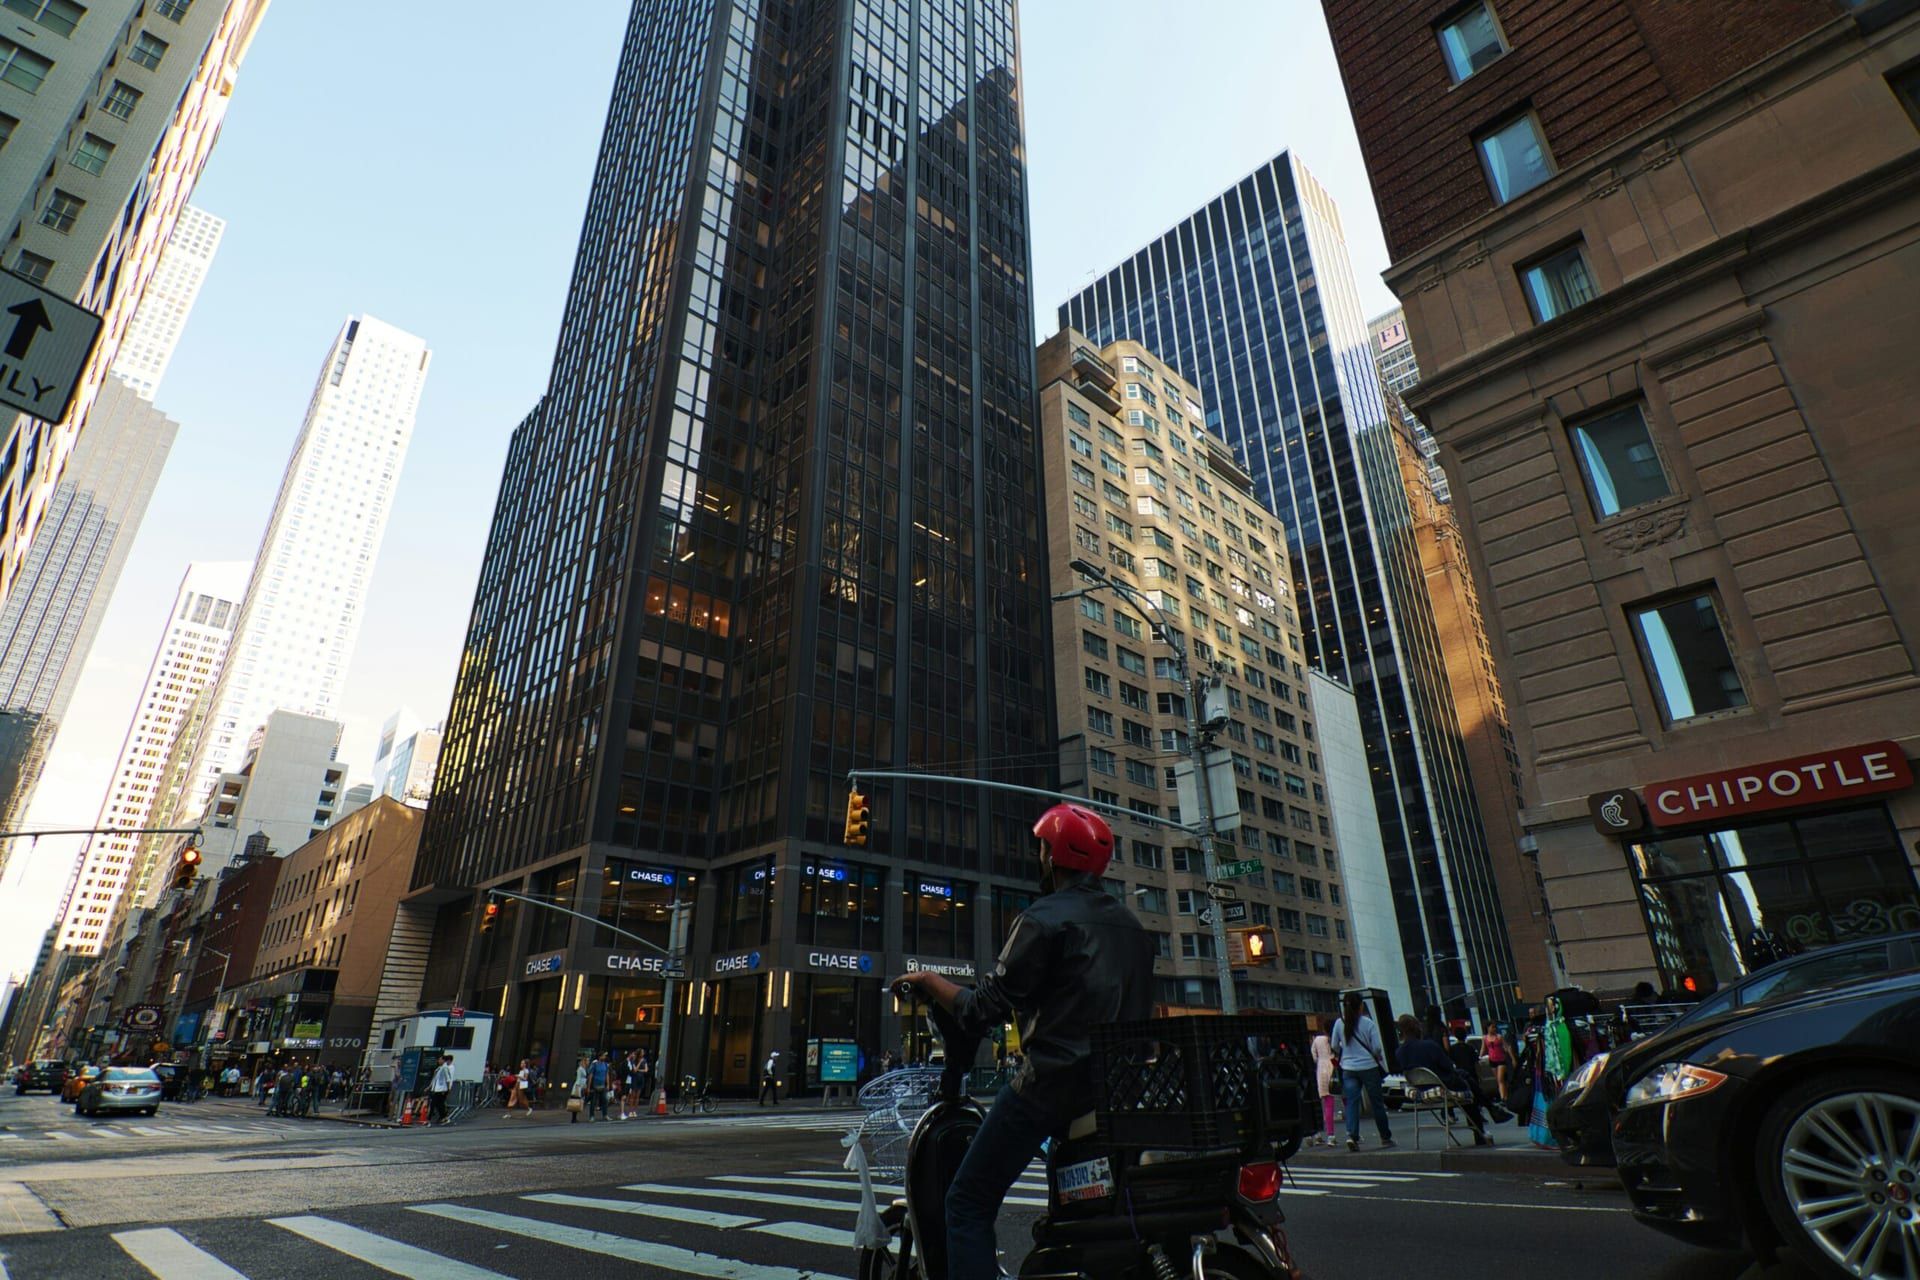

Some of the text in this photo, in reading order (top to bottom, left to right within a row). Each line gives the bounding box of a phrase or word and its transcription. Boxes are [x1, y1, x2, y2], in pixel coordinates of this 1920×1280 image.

[1380, 322, 1401, 343] FT
[1657, 751, 1897, 815] CHIPOTLE
[806, 865, 836, 878] CASE
[1240, 861, 1253, 874] 56
[631, 870, 663, 883] CHASE
[920, 883, 945, 896] CHASE
[526, 957, 552, 975] CHASE
[607, 955, 663, 972] CHASE
[715, 954, 748, 972] CHASE
[809, 952, 858, 969] CHASE
[329, 1037, 362, 1048] 1370
